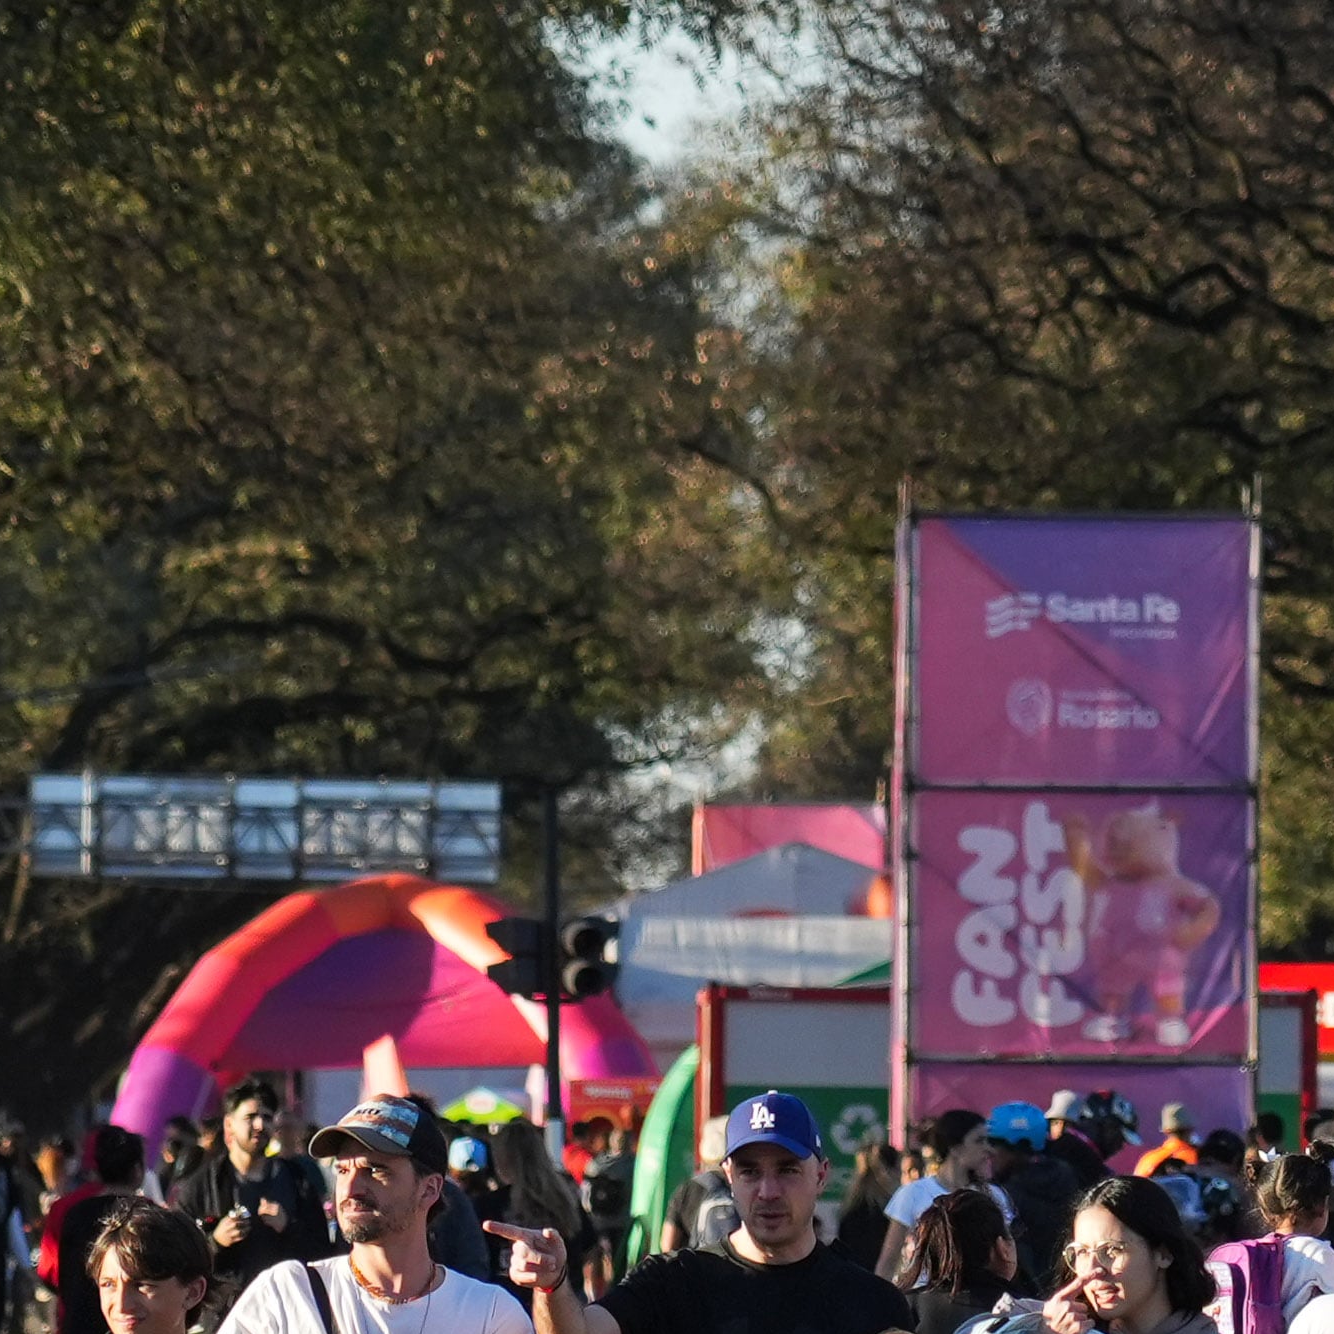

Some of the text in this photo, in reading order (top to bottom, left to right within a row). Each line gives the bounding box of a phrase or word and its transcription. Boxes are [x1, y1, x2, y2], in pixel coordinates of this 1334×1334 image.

[1046, 593, 1181, 624] Santa Fe
[954, 827, 1017, 1025] FAN
[1021, 802, 1084, 1025] FEST
[749, 1102, 775, 1130] LA
